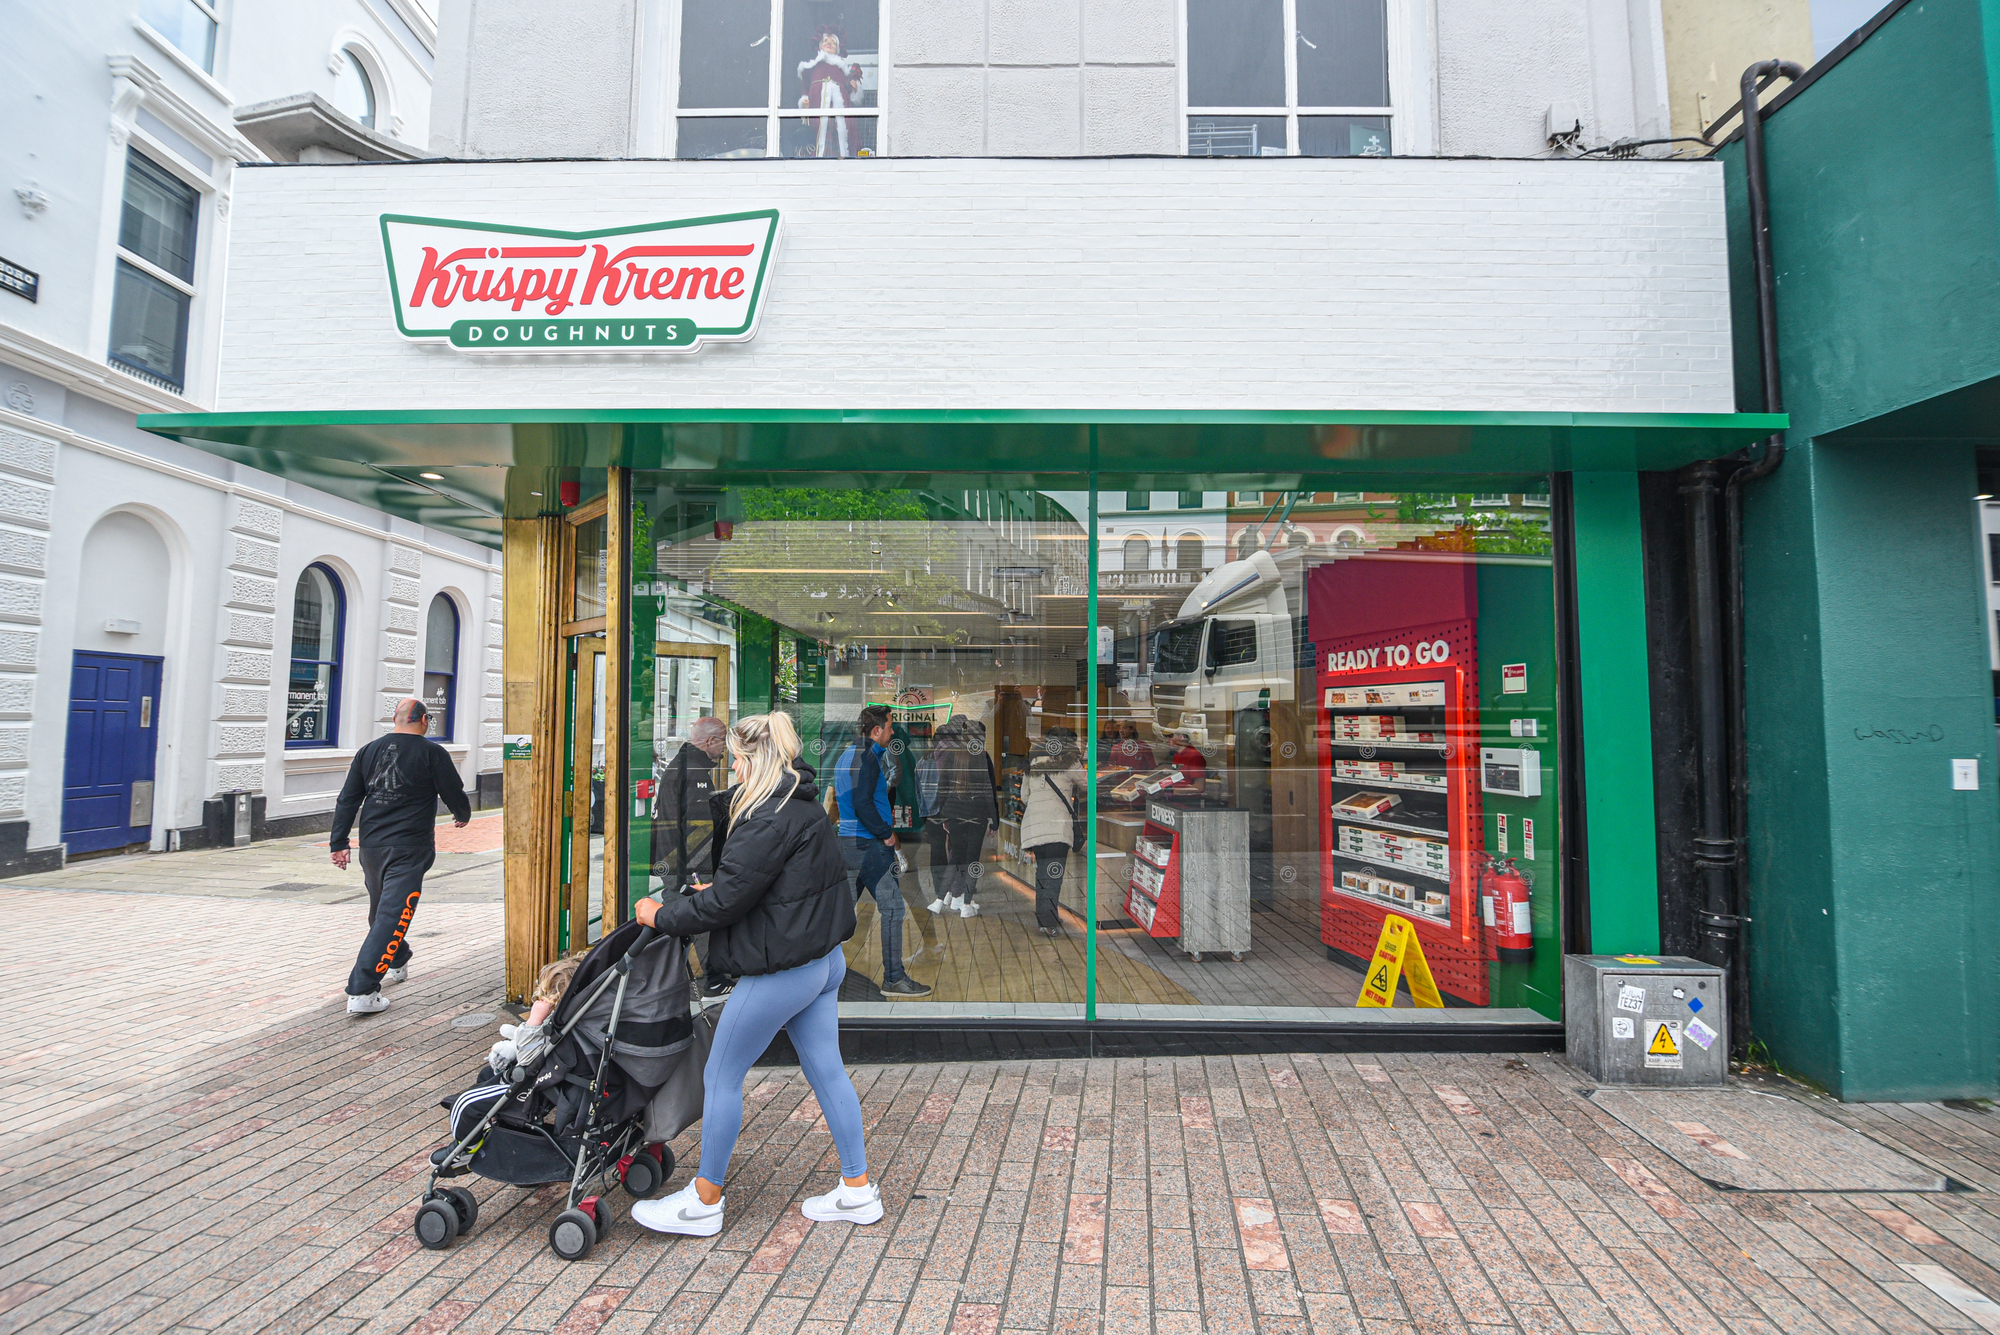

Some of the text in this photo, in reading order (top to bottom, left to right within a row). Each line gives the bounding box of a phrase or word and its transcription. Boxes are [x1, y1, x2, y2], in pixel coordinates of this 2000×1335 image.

[409, 243, 755, 316] Krispy Kreme
[468, 324, 679, 342] DOUGHNUTS
[1327, 639, 1450, 672] READY TO GO
[892, 687, 908, 702] HOME
[917, 690, 927, 702] THE
[891, 712, 938, 722] RIGINAL
[1151, 804, 1176, 827] EXPRESS
[375, 891, 421, 974] Carrots
